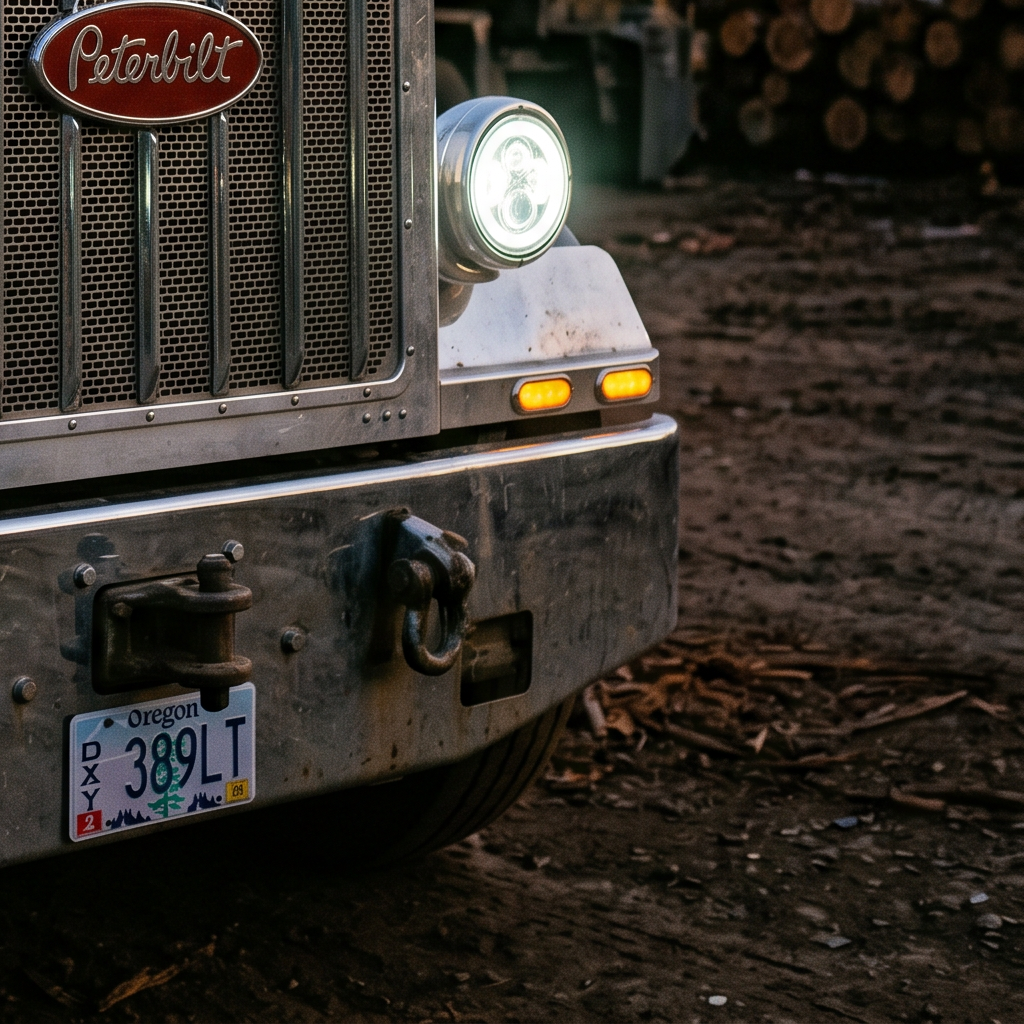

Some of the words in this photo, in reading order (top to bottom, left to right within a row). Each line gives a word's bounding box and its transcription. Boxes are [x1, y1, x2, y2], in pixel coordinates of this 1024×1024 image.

[68, 24, 244, 92] Peterbilt
[128, 702, 200, 729] Oregon
[125, 716, 246, 799] 389LT
[82, 814, 95, 832] 2
